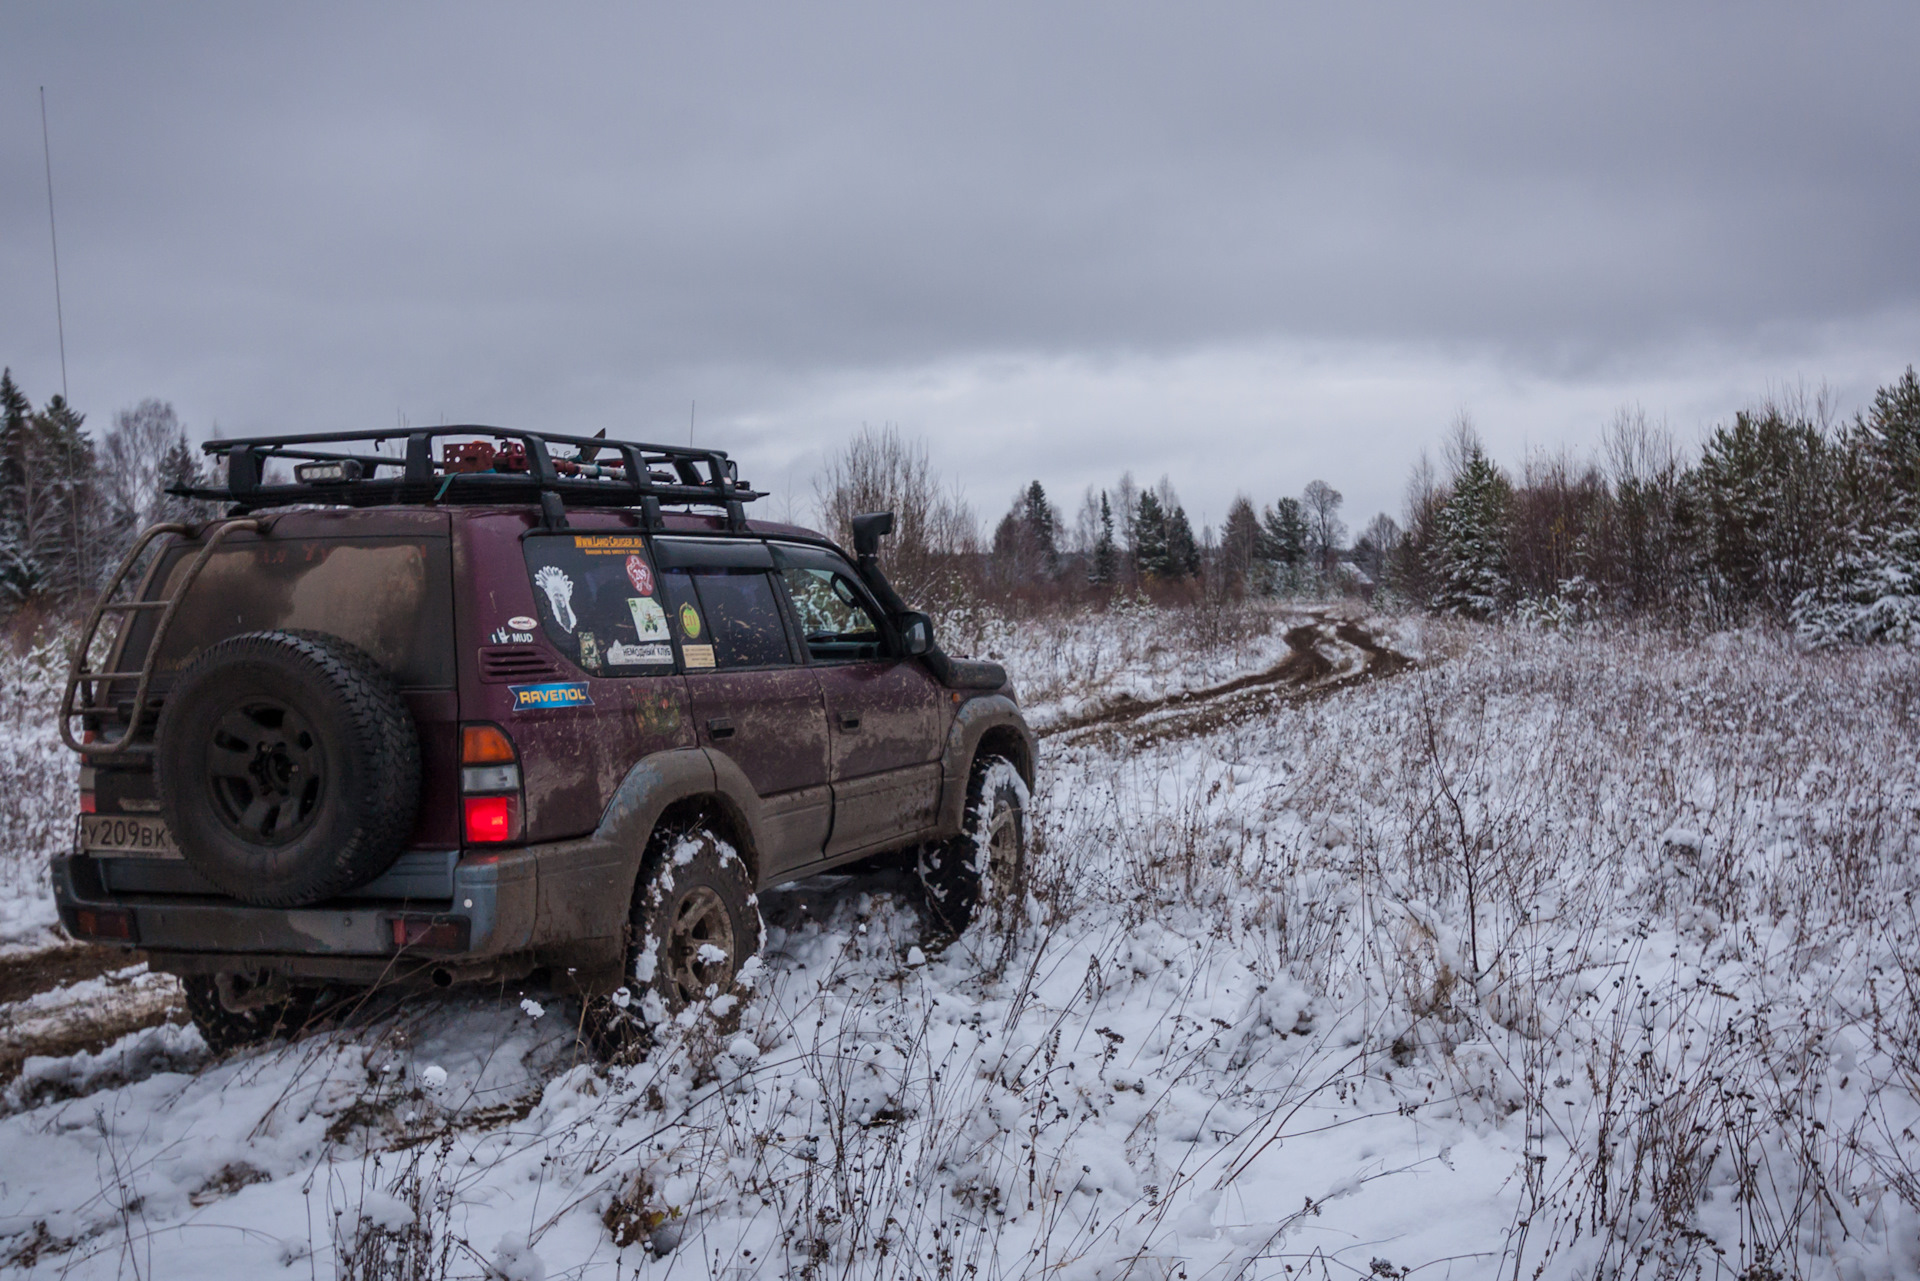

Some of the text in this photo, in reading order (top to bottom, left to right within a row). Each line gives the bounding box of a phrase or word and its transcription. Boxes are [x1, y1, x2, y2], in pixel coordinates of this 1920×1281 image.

[512, 633, 533, 643] MUD
[657, 647, 671, 657] КЛУБ
[519, 688, 586, 704] RAVENOL
